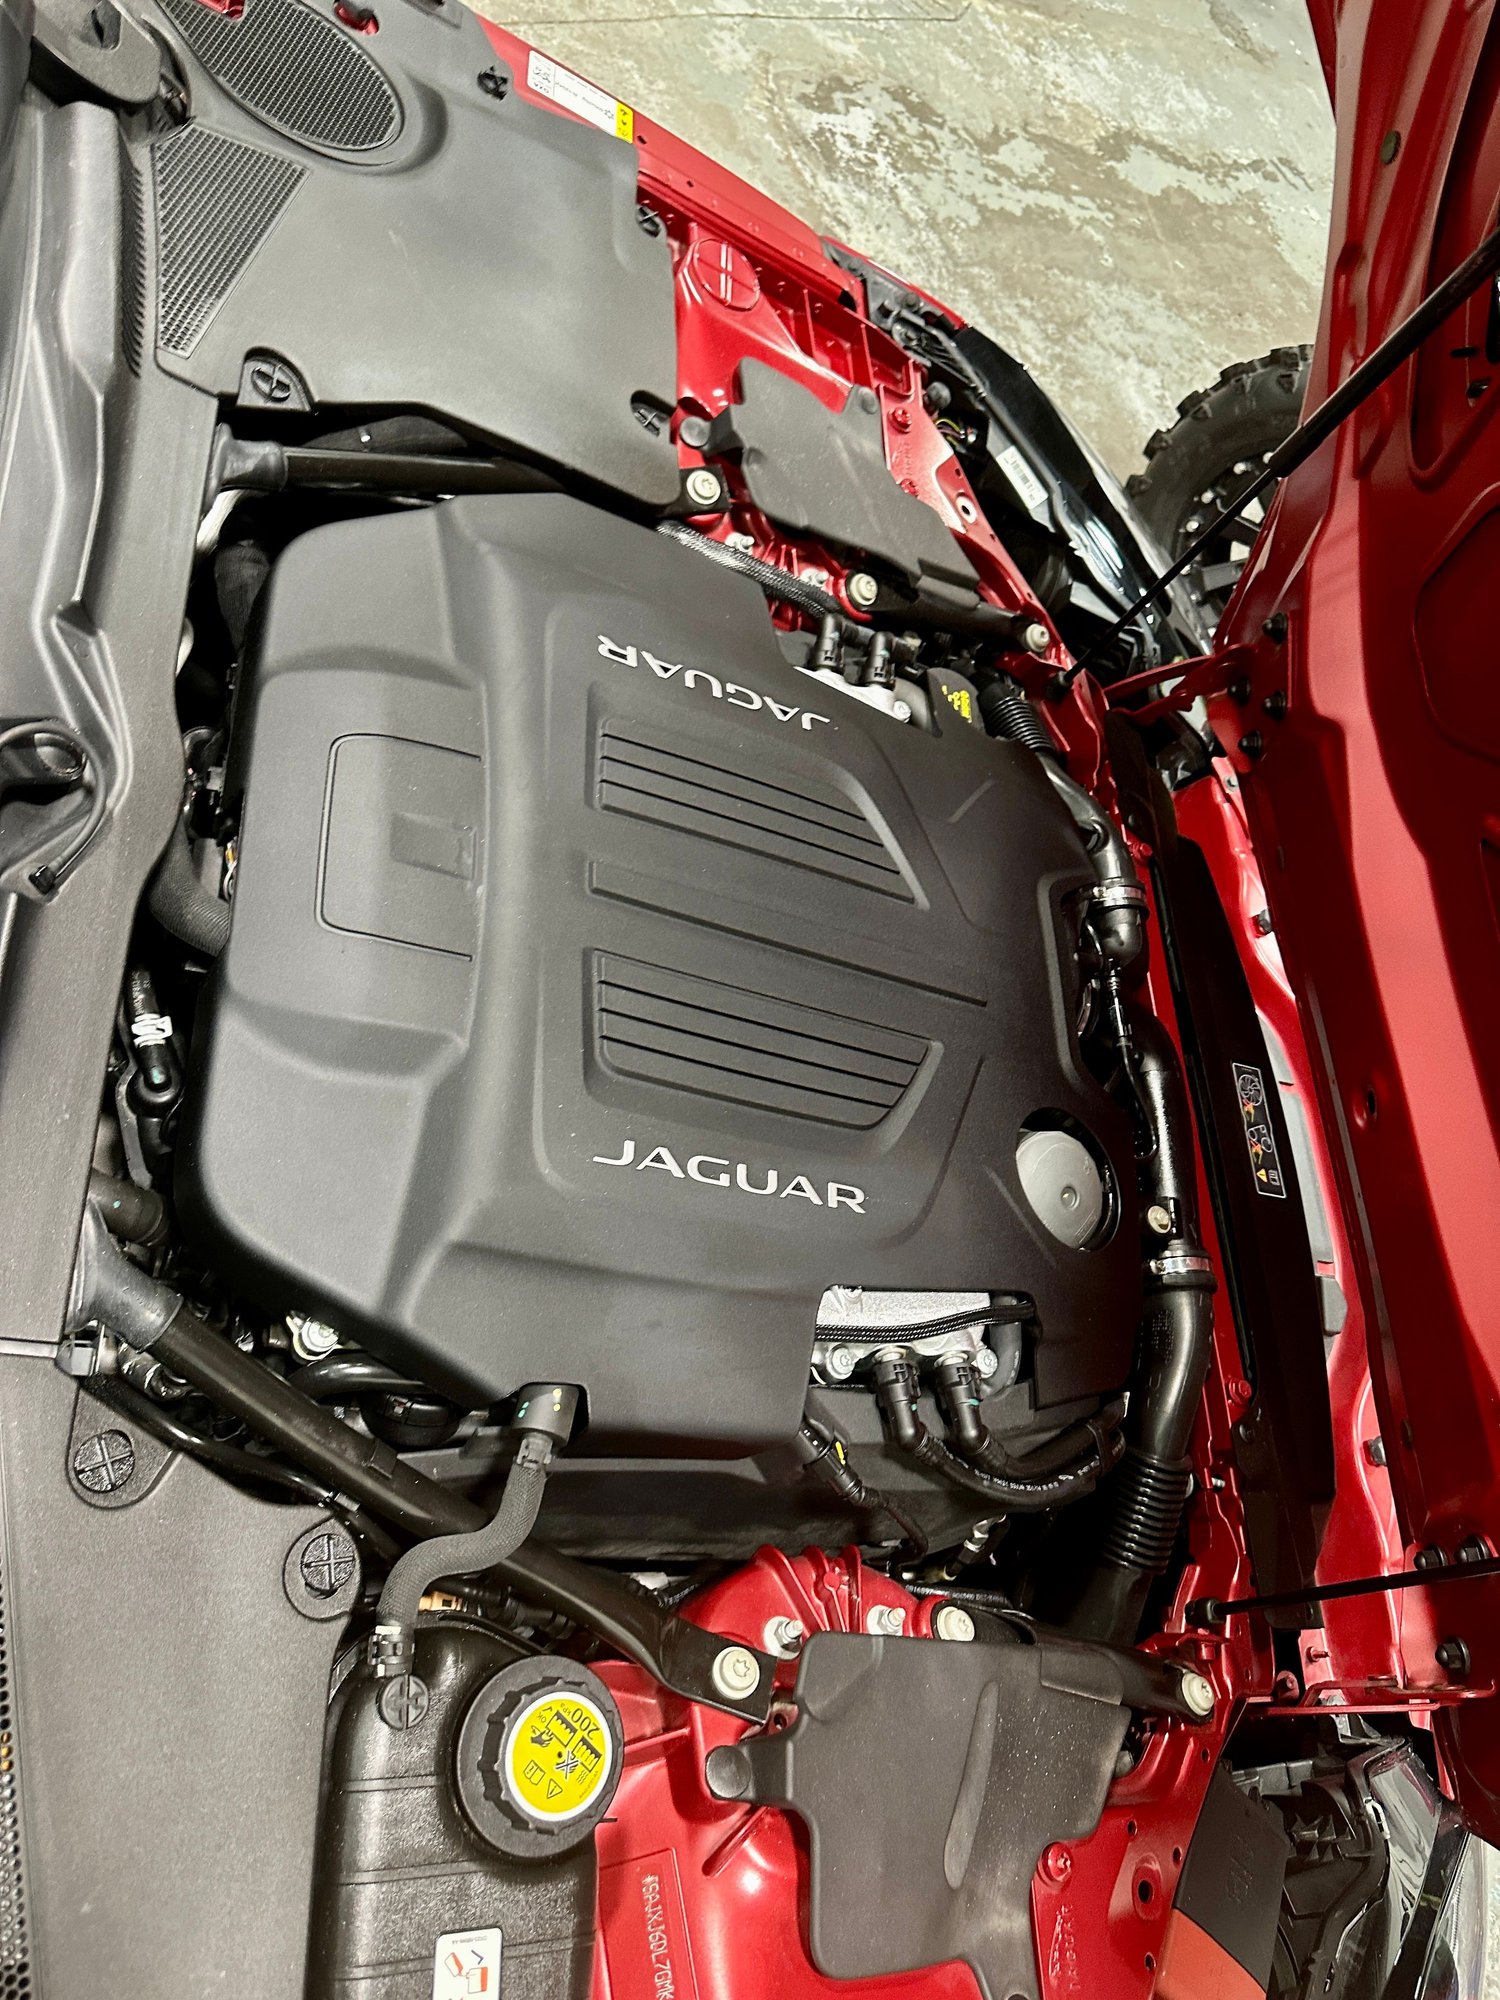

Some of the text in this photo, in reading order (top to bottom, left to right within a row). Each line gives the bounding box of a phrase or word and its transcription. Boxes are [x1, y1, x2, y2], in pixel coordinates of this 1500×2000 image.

[598, 635, 830, 730] JAGUAR
[592, 1139, 866, 1214] JAGUAR
[537, 1711, 547, 1723] OK
[571, 1707, 601, 1741] 200
